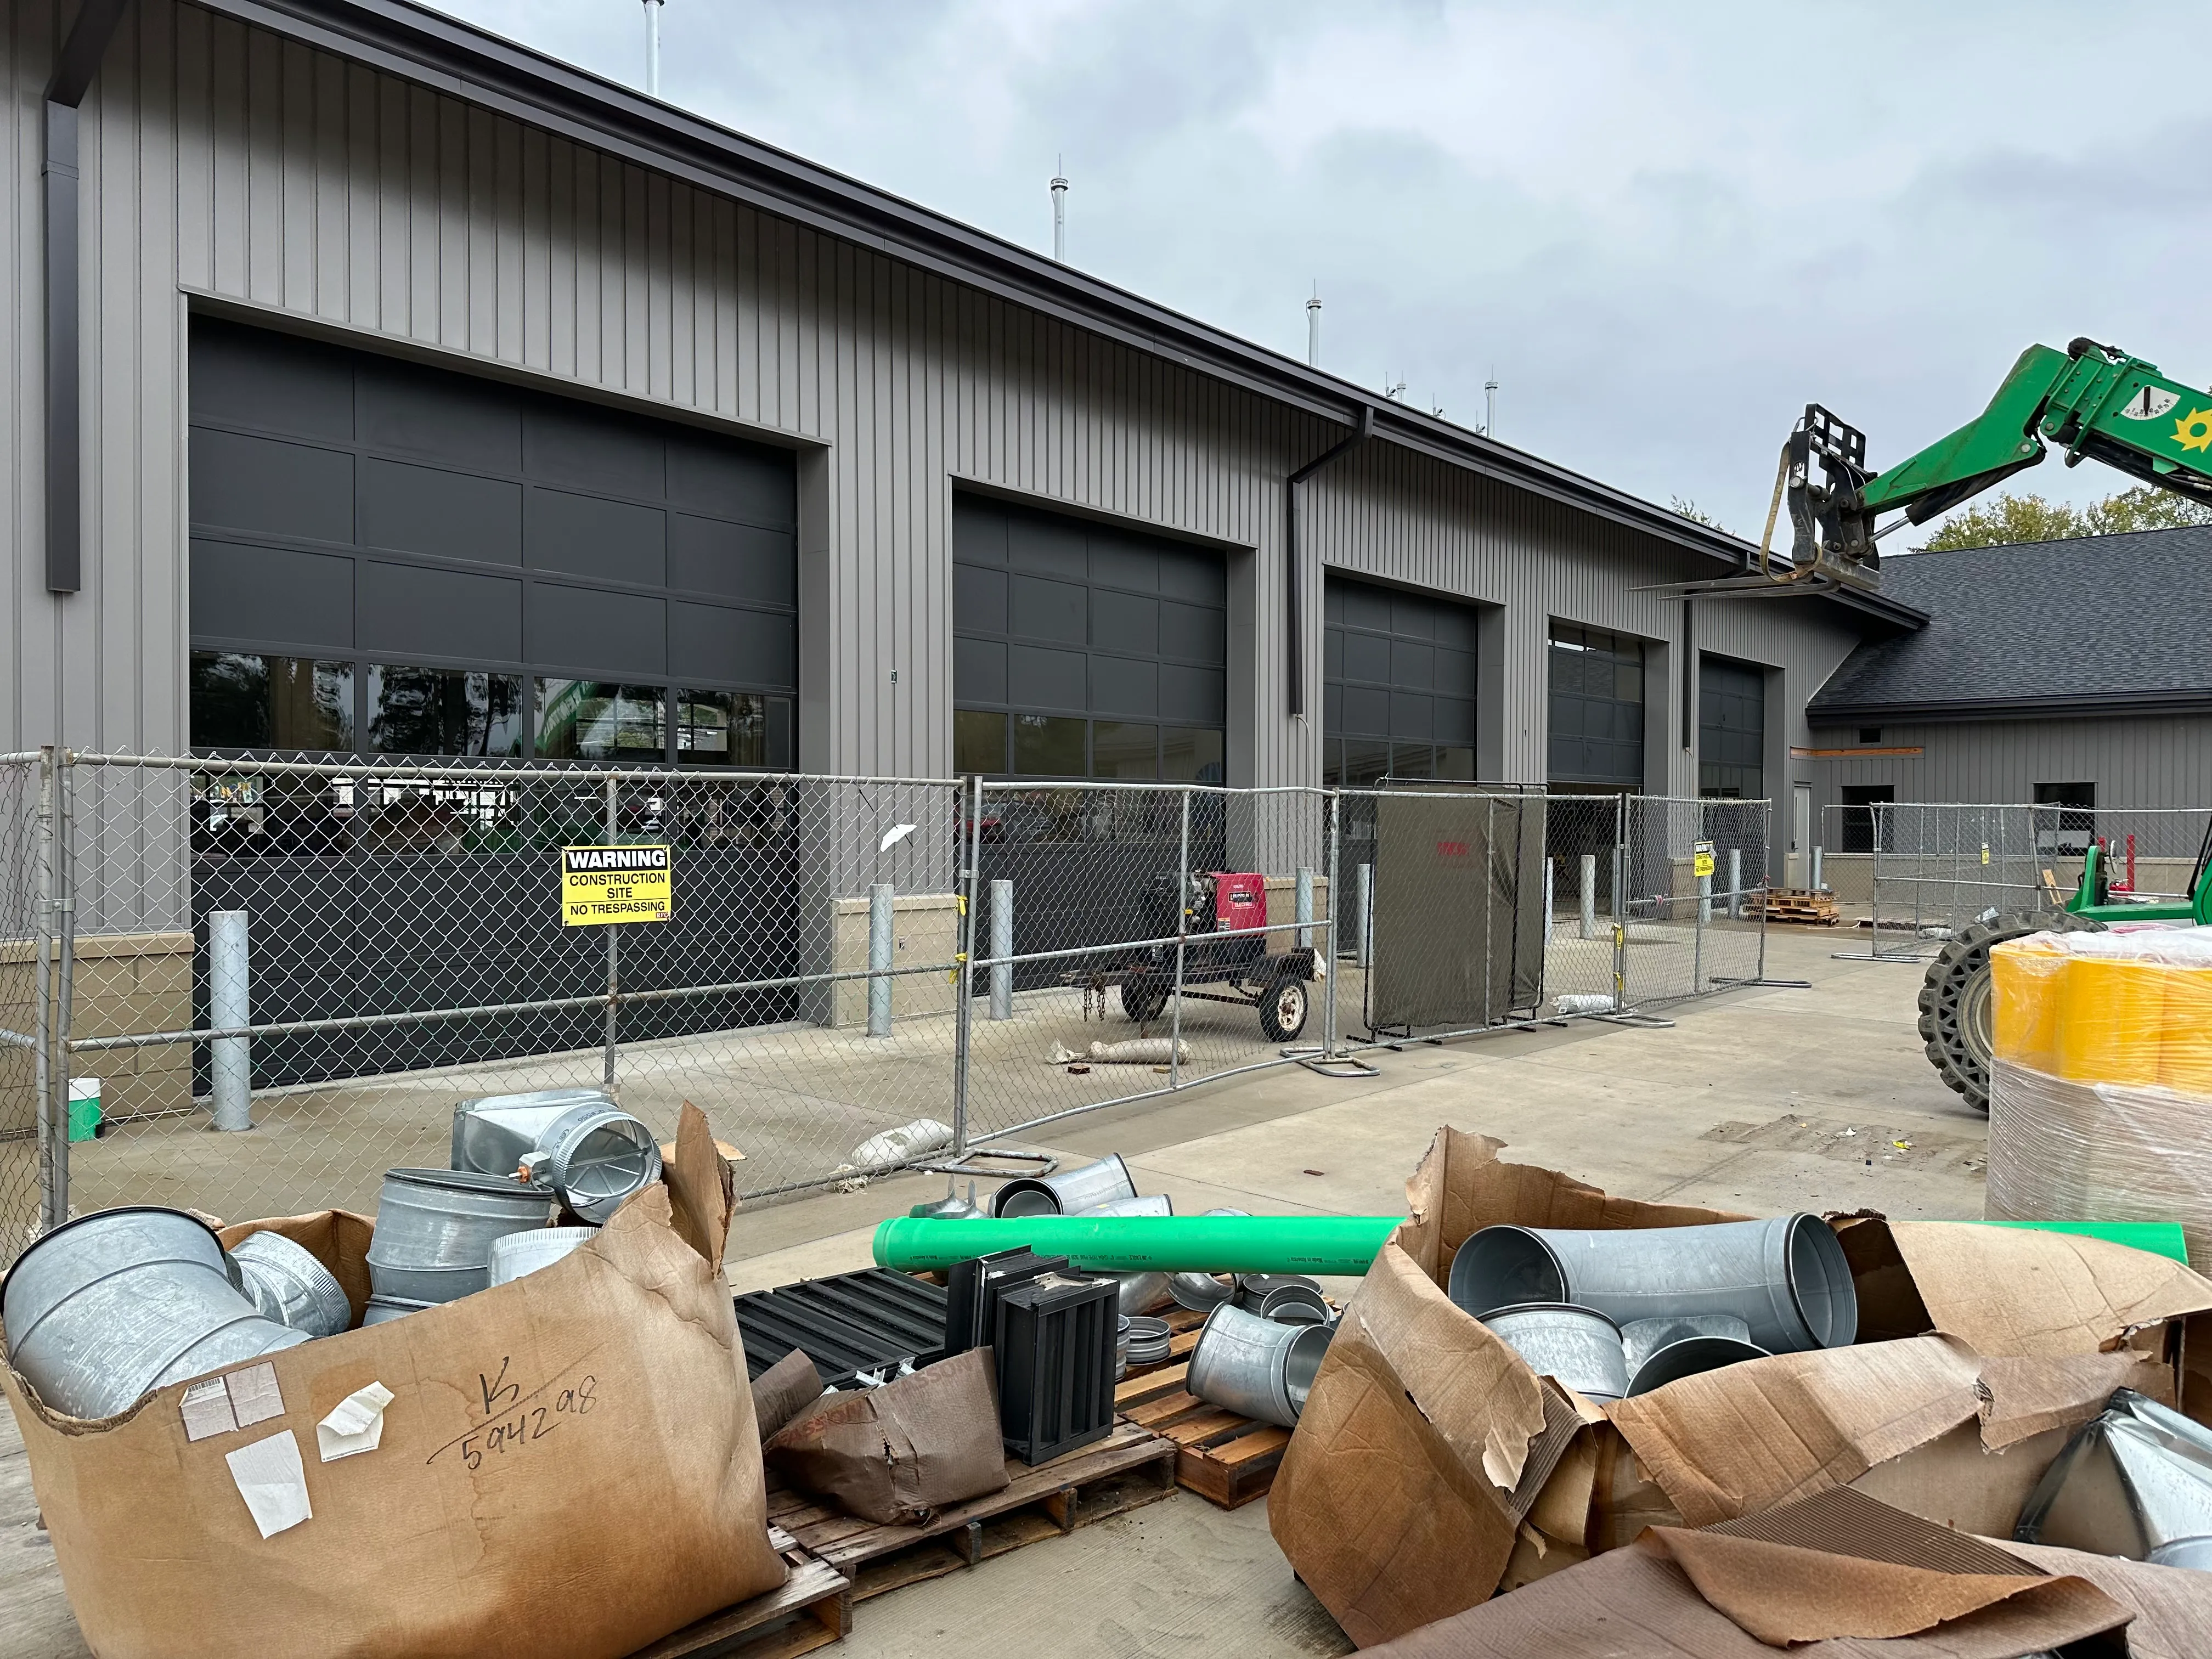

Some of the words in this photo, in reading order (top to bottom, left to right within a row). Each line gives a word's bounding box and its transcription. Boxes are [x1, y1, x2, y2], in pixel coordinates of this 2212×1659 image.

[568, 850, 665, 868] WARNING
[569, 873, 665, 886] CONSTRUCTION
[607, 887, 633, 899] SITE
[571, 905, 588, 915] NO
[591, 901, 665, 914] TRESPASSING
